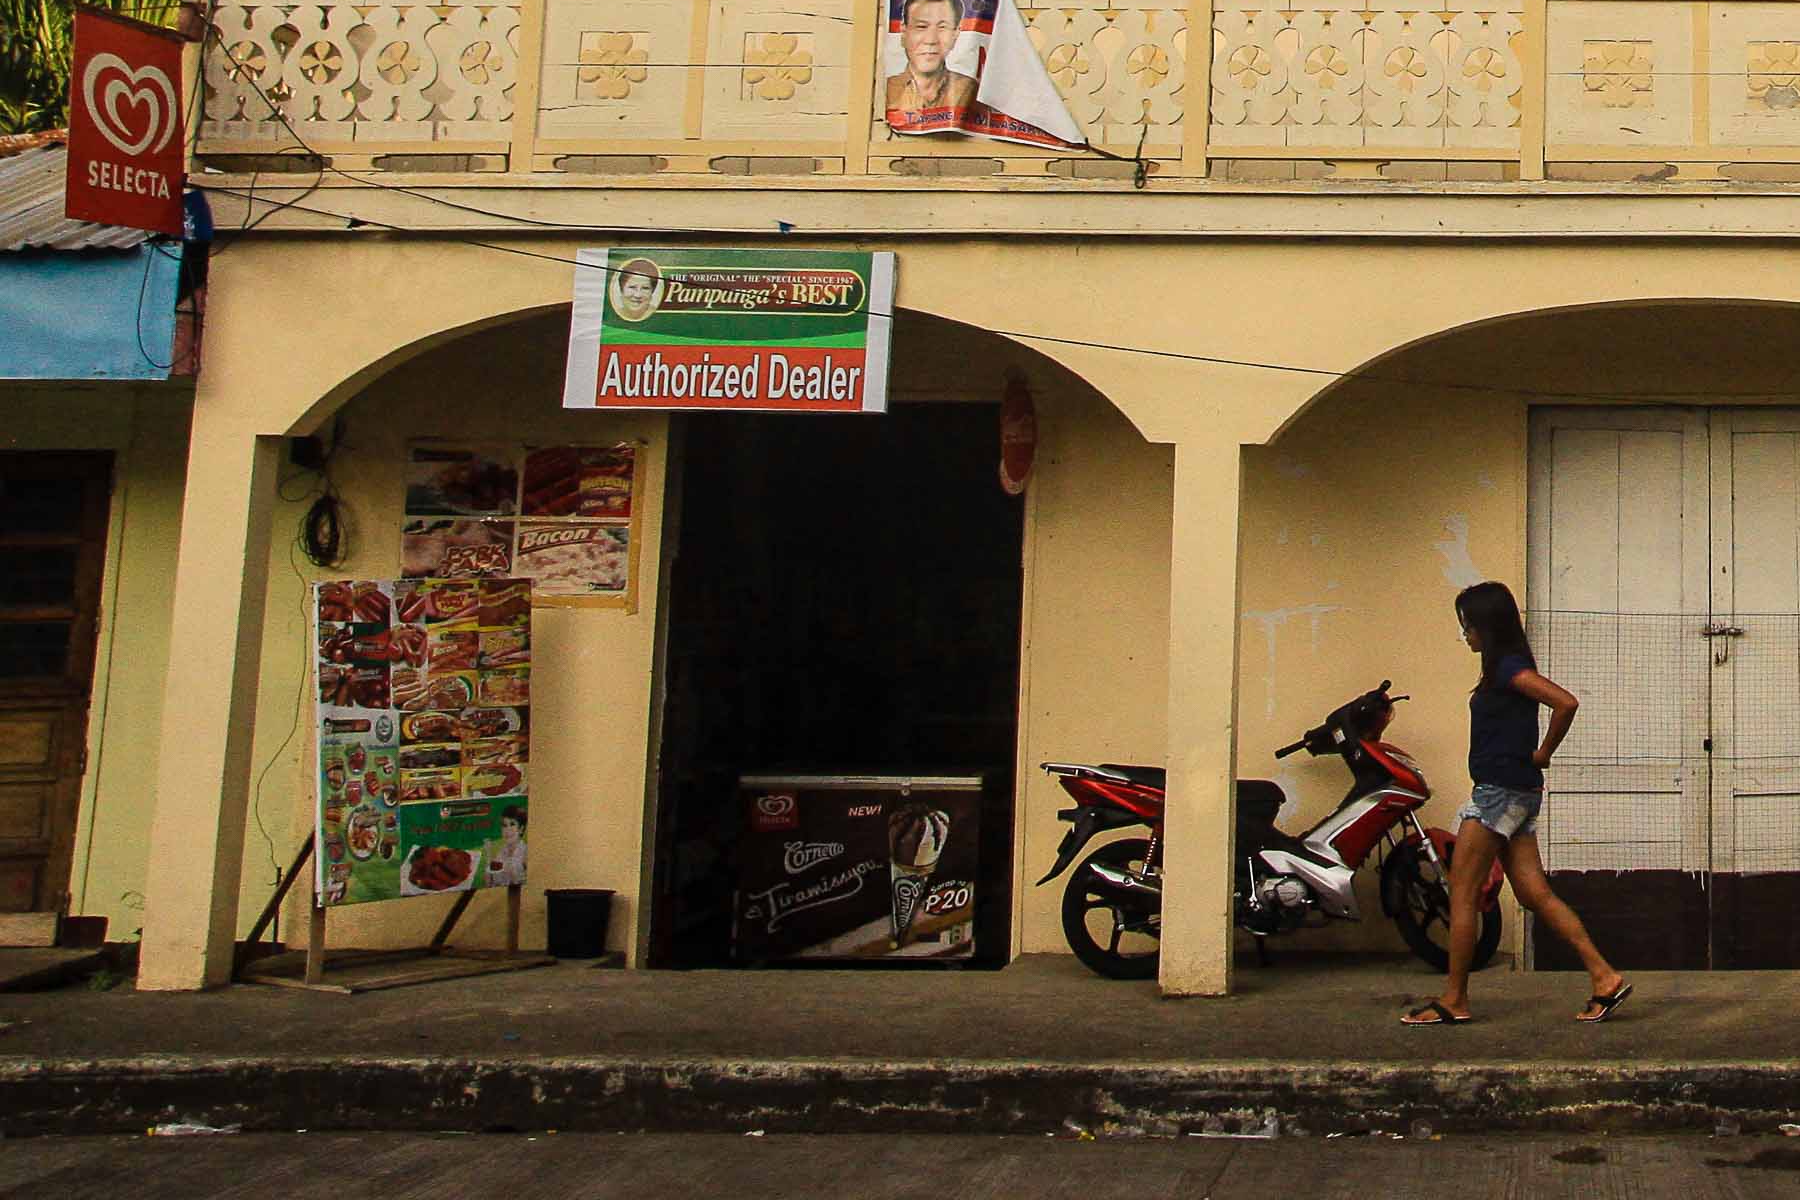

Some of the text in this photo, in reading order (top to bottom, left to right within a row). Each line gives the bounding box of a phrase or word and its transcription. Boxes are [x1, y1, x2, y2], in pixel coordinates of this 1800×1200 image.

[88, 160, 170, 200] SELECTA
[669, 274, 688, 282] THE
[743, 275, 760, 283] THE
[808, 276, 833, 284] SINCE
[790, 283, 853, 306] BEST
[600, 352, 861, 401] Authorized Dealer
[521, 529, 590, 549] Bacon
[848, 804, 882, 817] NEW!
[784, 841, 845, 874] Cornetto
